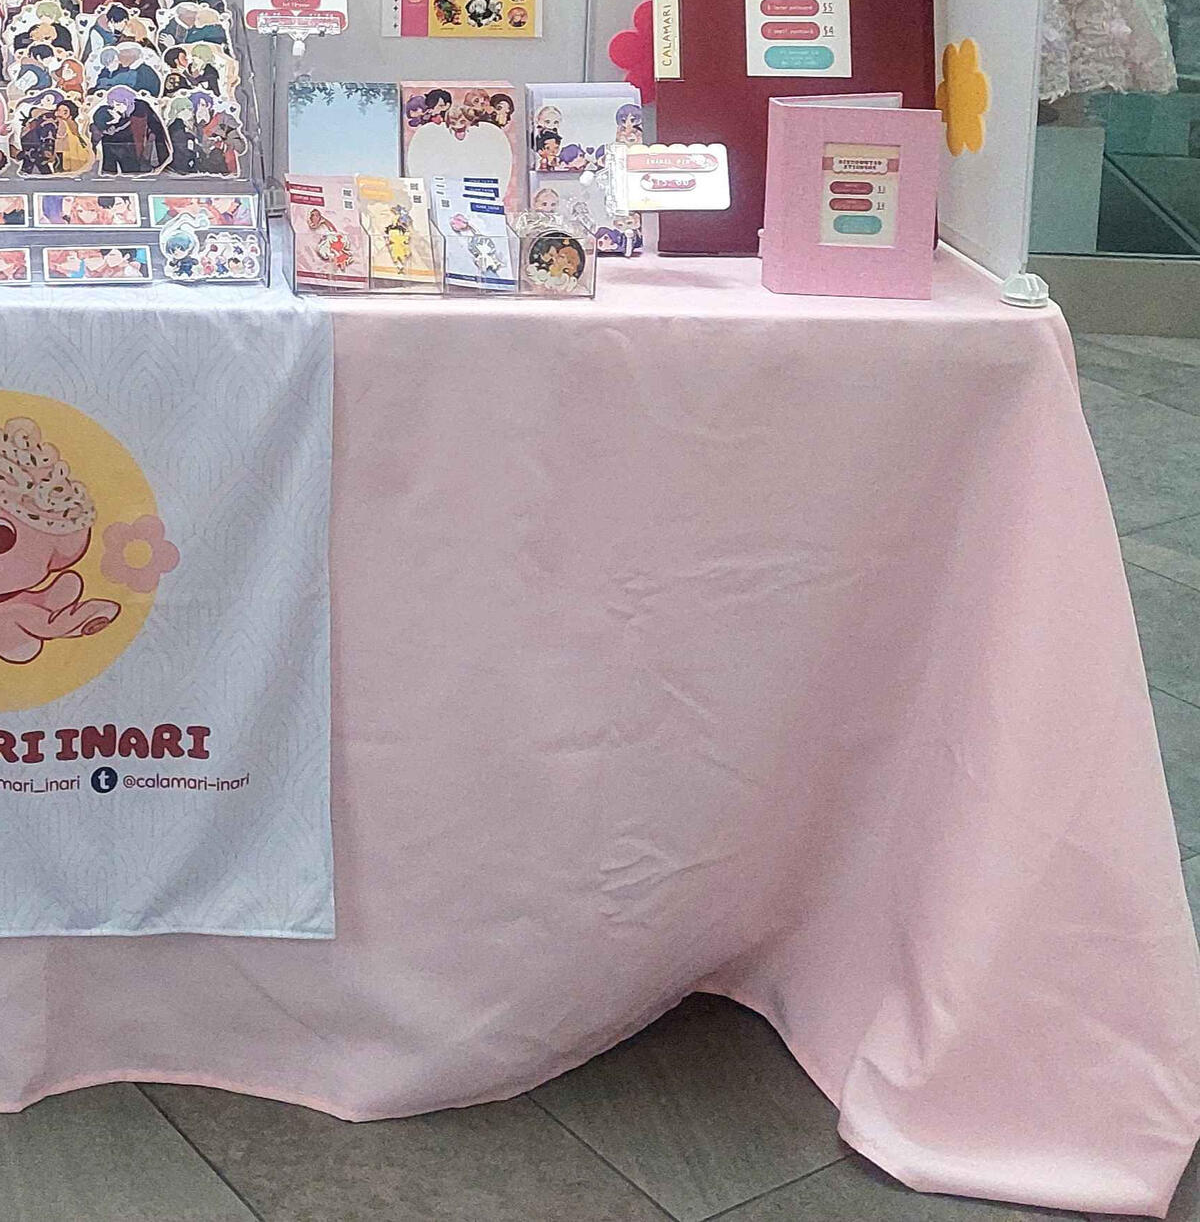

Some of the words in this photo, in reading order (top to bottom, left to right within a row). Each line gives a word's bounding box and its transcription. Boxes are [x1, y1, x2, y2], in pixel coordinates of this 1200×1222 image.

[823, 2, 833, 12] $5
[662, 4, 672, 66] CALAMARI
[823, 25, 834, 35] $4
[55, 723, 211, 760] INARI
[122, 772, 250, 792] @calamari-inari
